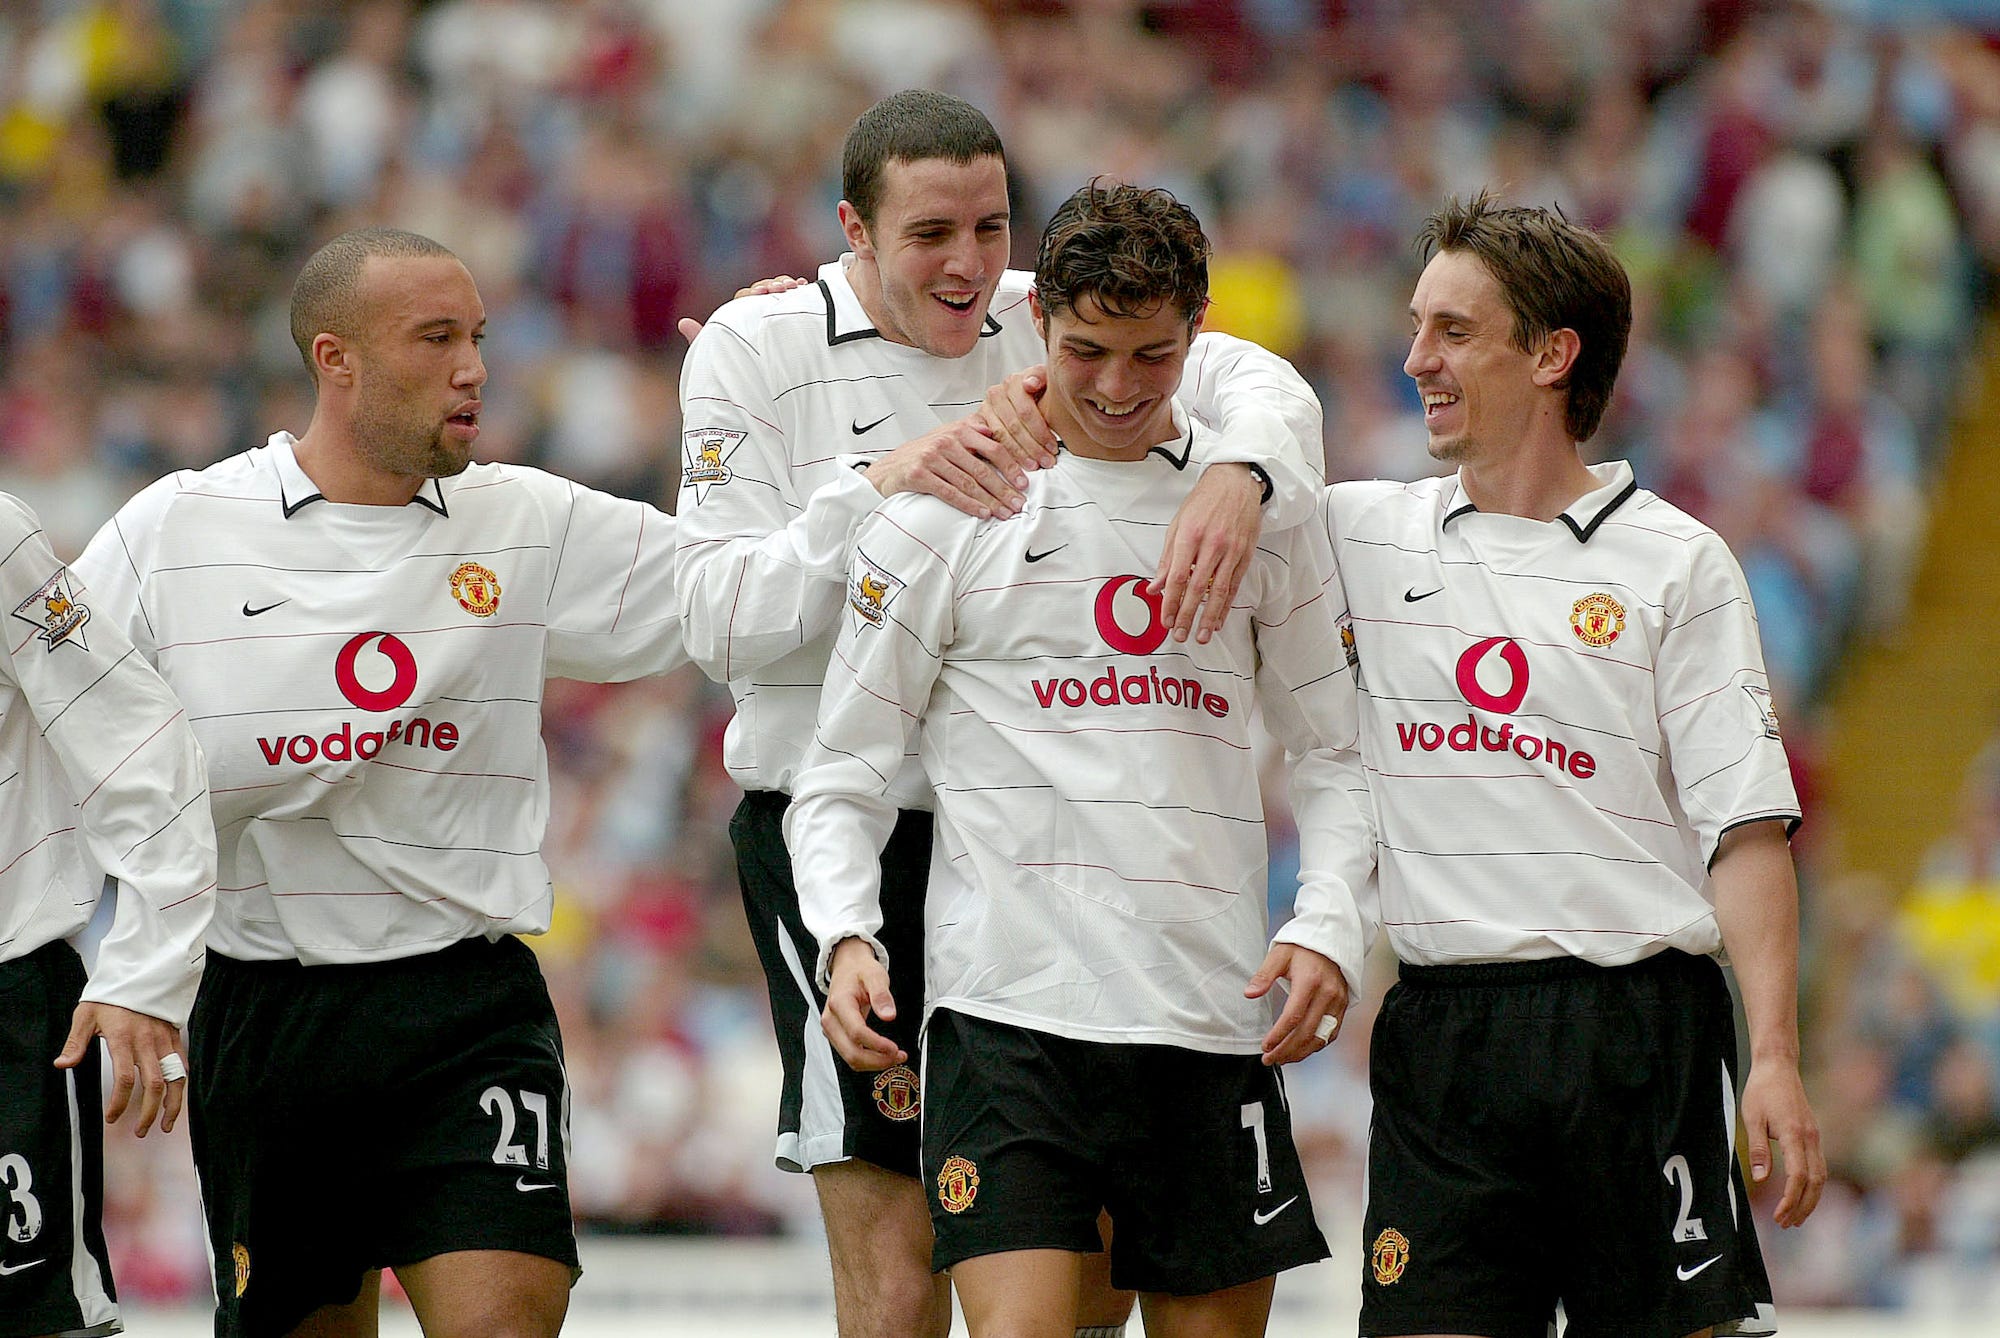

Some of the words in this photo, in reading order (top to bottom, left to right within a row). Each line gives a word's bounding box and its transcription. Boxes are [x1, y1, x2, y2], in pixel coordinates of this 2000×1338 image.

[467, 601, 495, 614] UNITED
[1575, 595, 1625, 618] MANCHESTER
[1579, 631, 1611, 644] UNITED
[1031, 665, 1230, 718] vodafone
[256, 718, 459, 766] vodafne
[1396, 713, 1597, 779] vodafone
[479, 1086, 549, 1171] 27
[884, 1107, 916, 1119] UNITED
[0, 1153, 42, 1243] 3
[1662, 1154, 1709, 1243] 2
